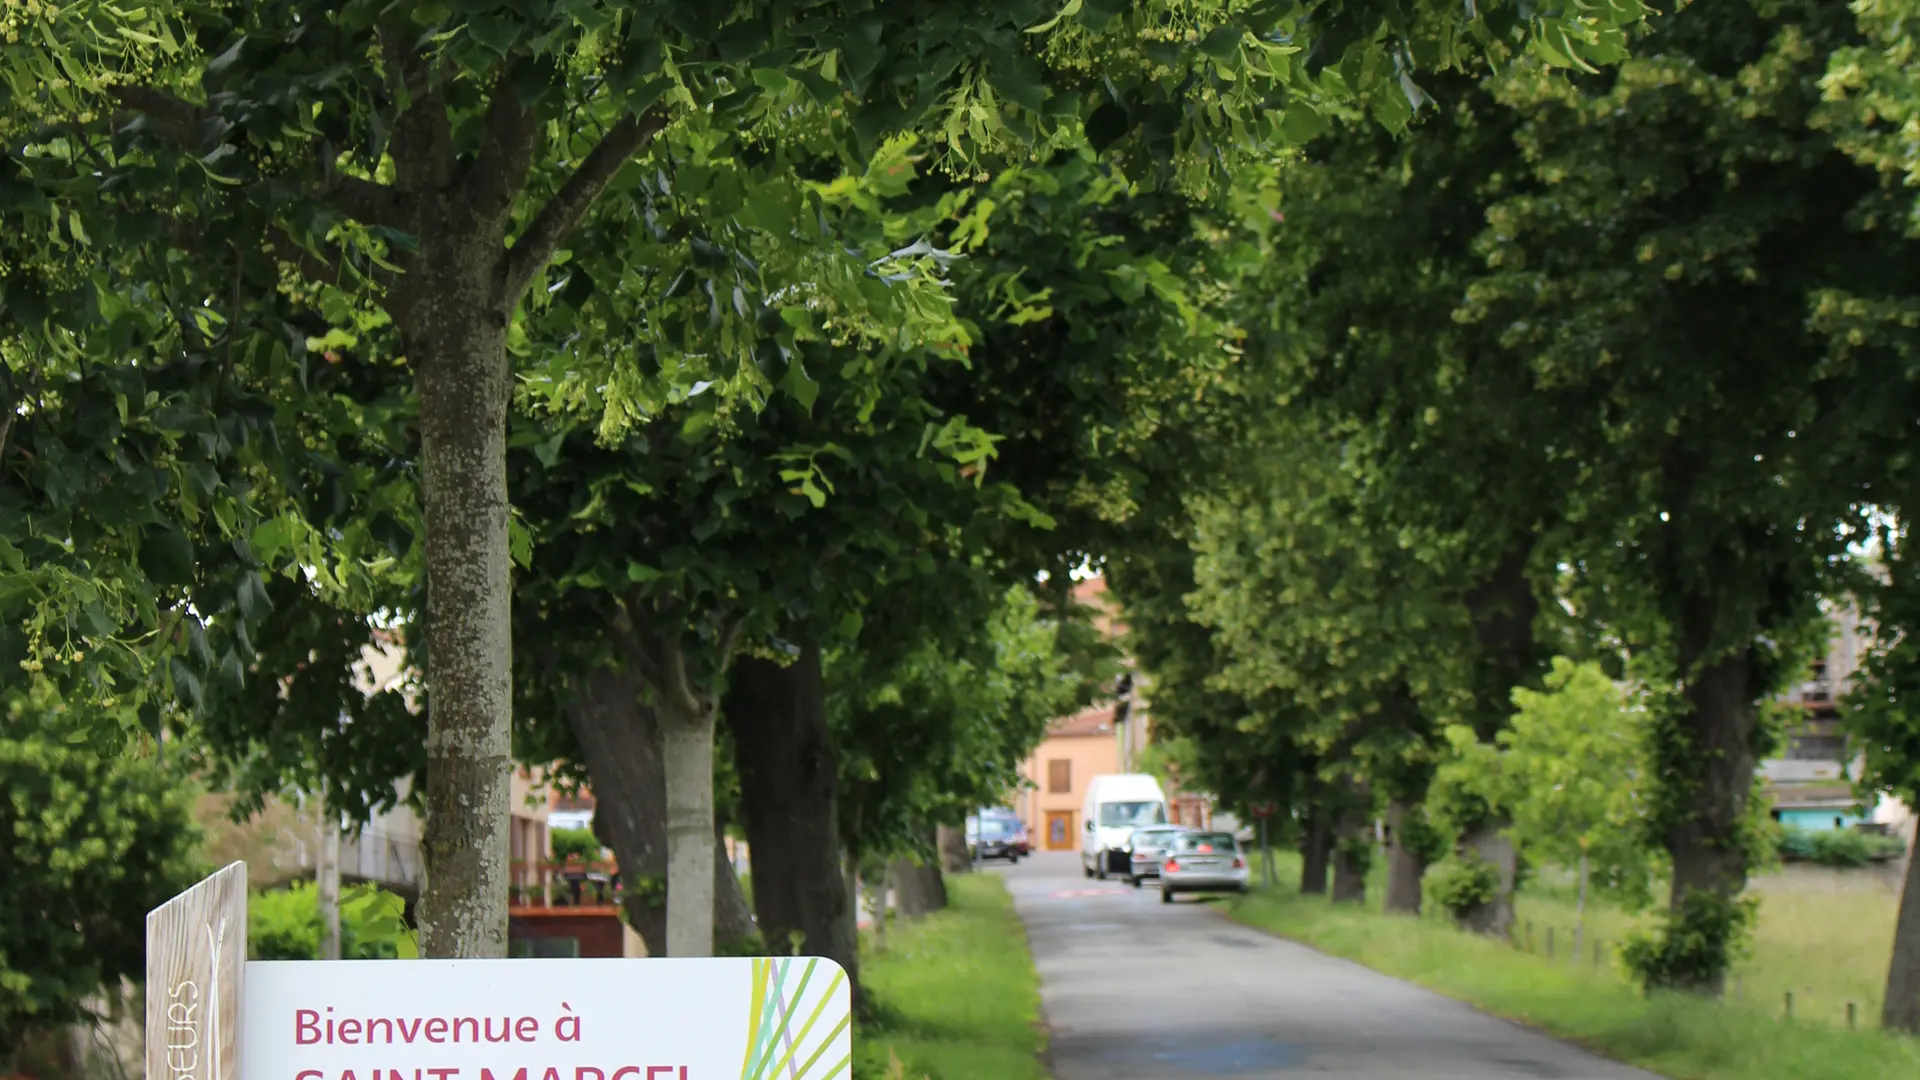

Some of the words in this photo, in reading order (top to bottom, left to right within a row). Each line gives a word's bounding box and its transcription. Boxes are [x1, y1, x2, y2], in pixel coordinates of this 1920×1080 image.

[167, 980, 198, 1080] EURS
[295, 1006, 539, 1045] Bienvenue
[555, 1002, 581, 1042] à
